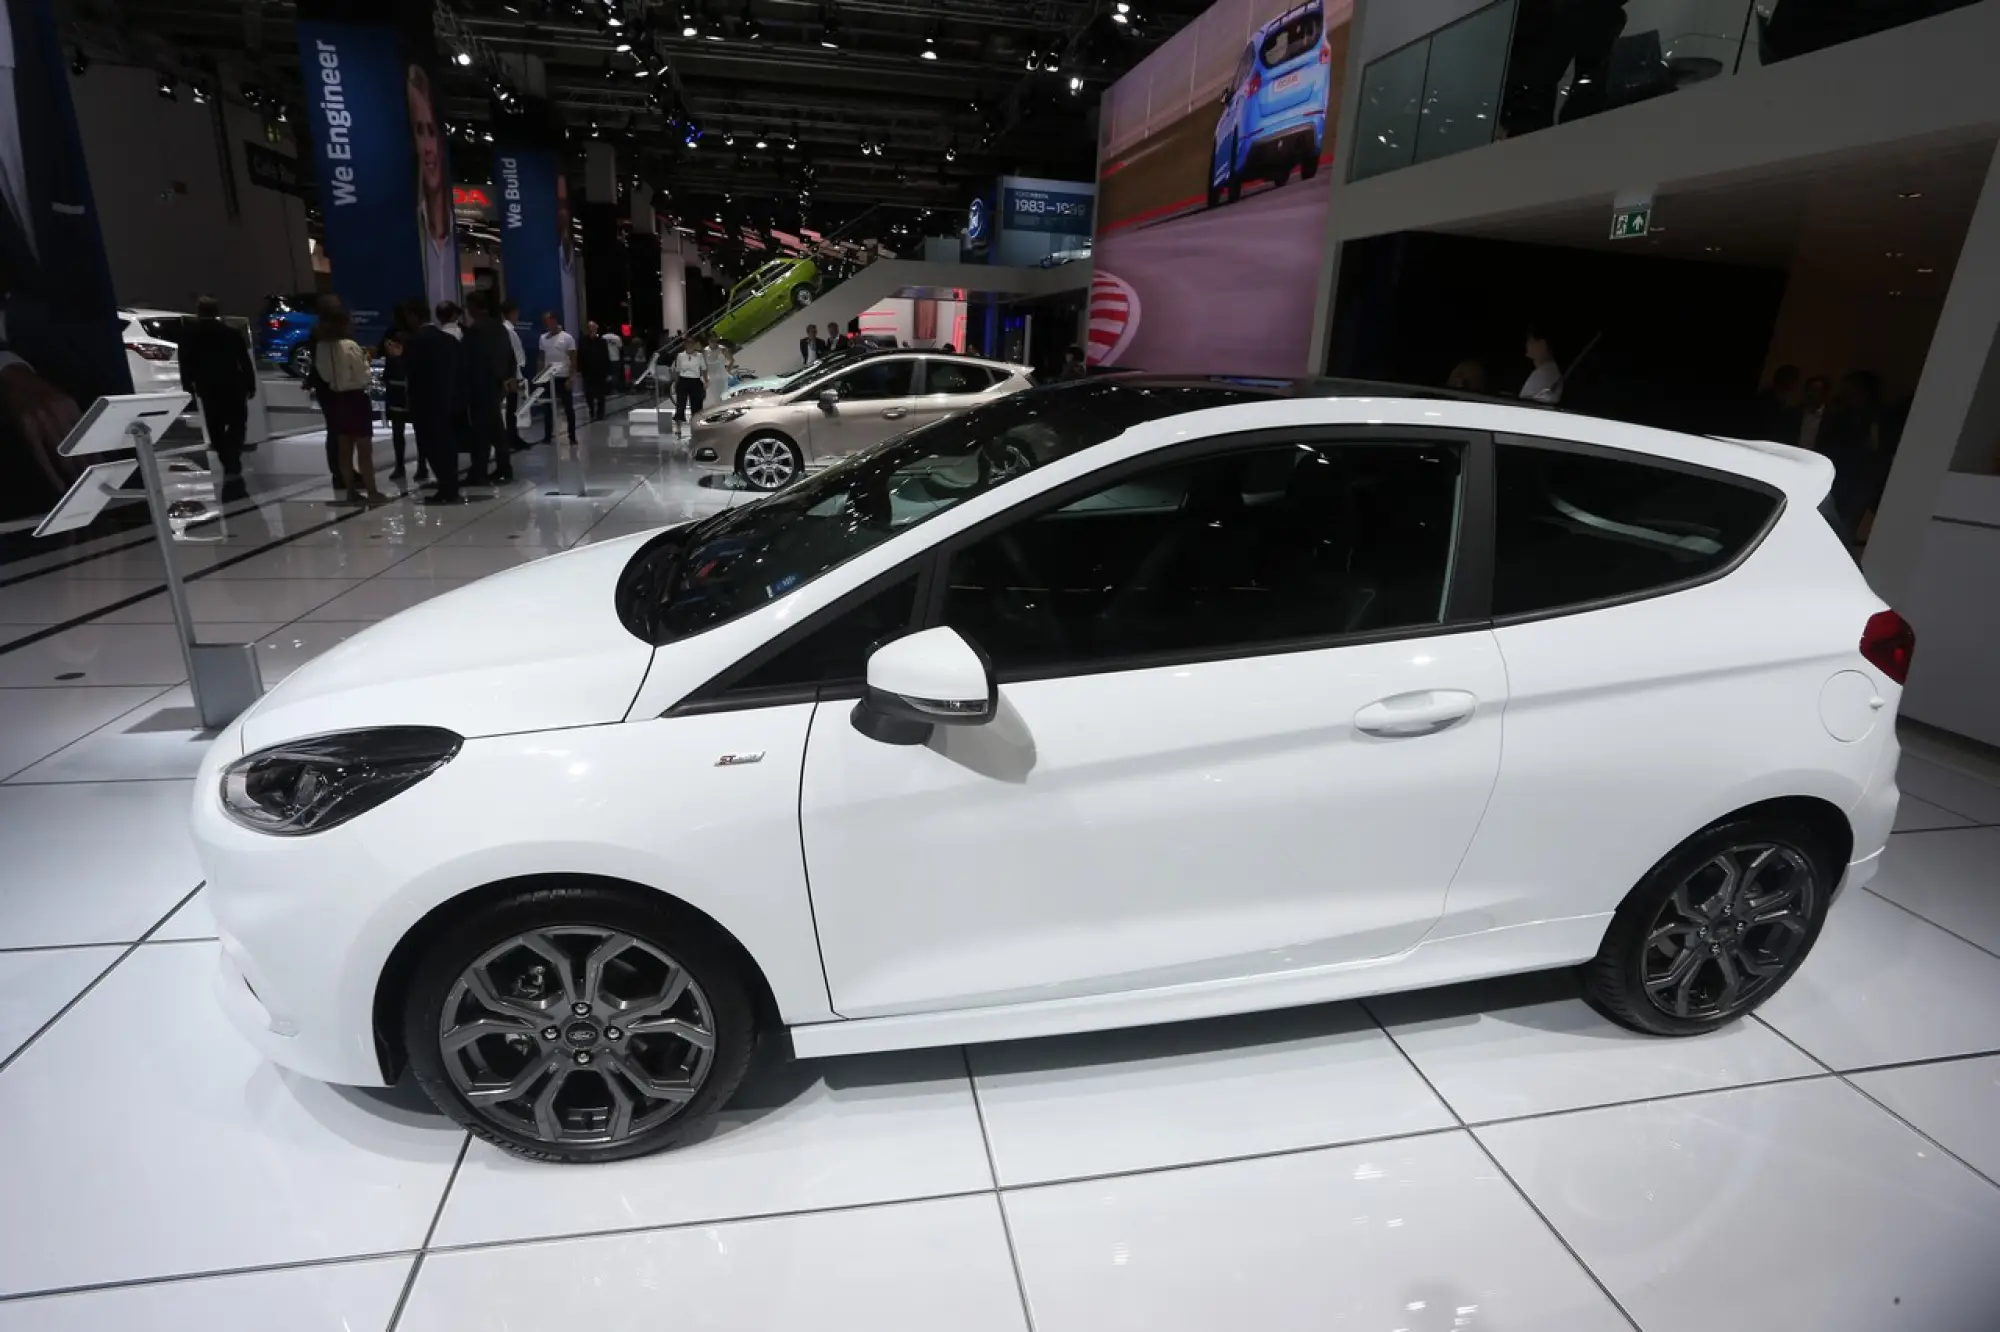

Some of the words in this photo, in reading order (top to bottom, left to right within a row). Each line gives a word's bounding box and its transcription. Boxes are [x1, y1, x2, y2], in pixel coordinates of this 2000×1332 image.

[316, 39, 352, 159] Engineer
[331, 166, 357, 206] We
[501, 158, 520, 200] Build
[507, 203, 522, 228] We
